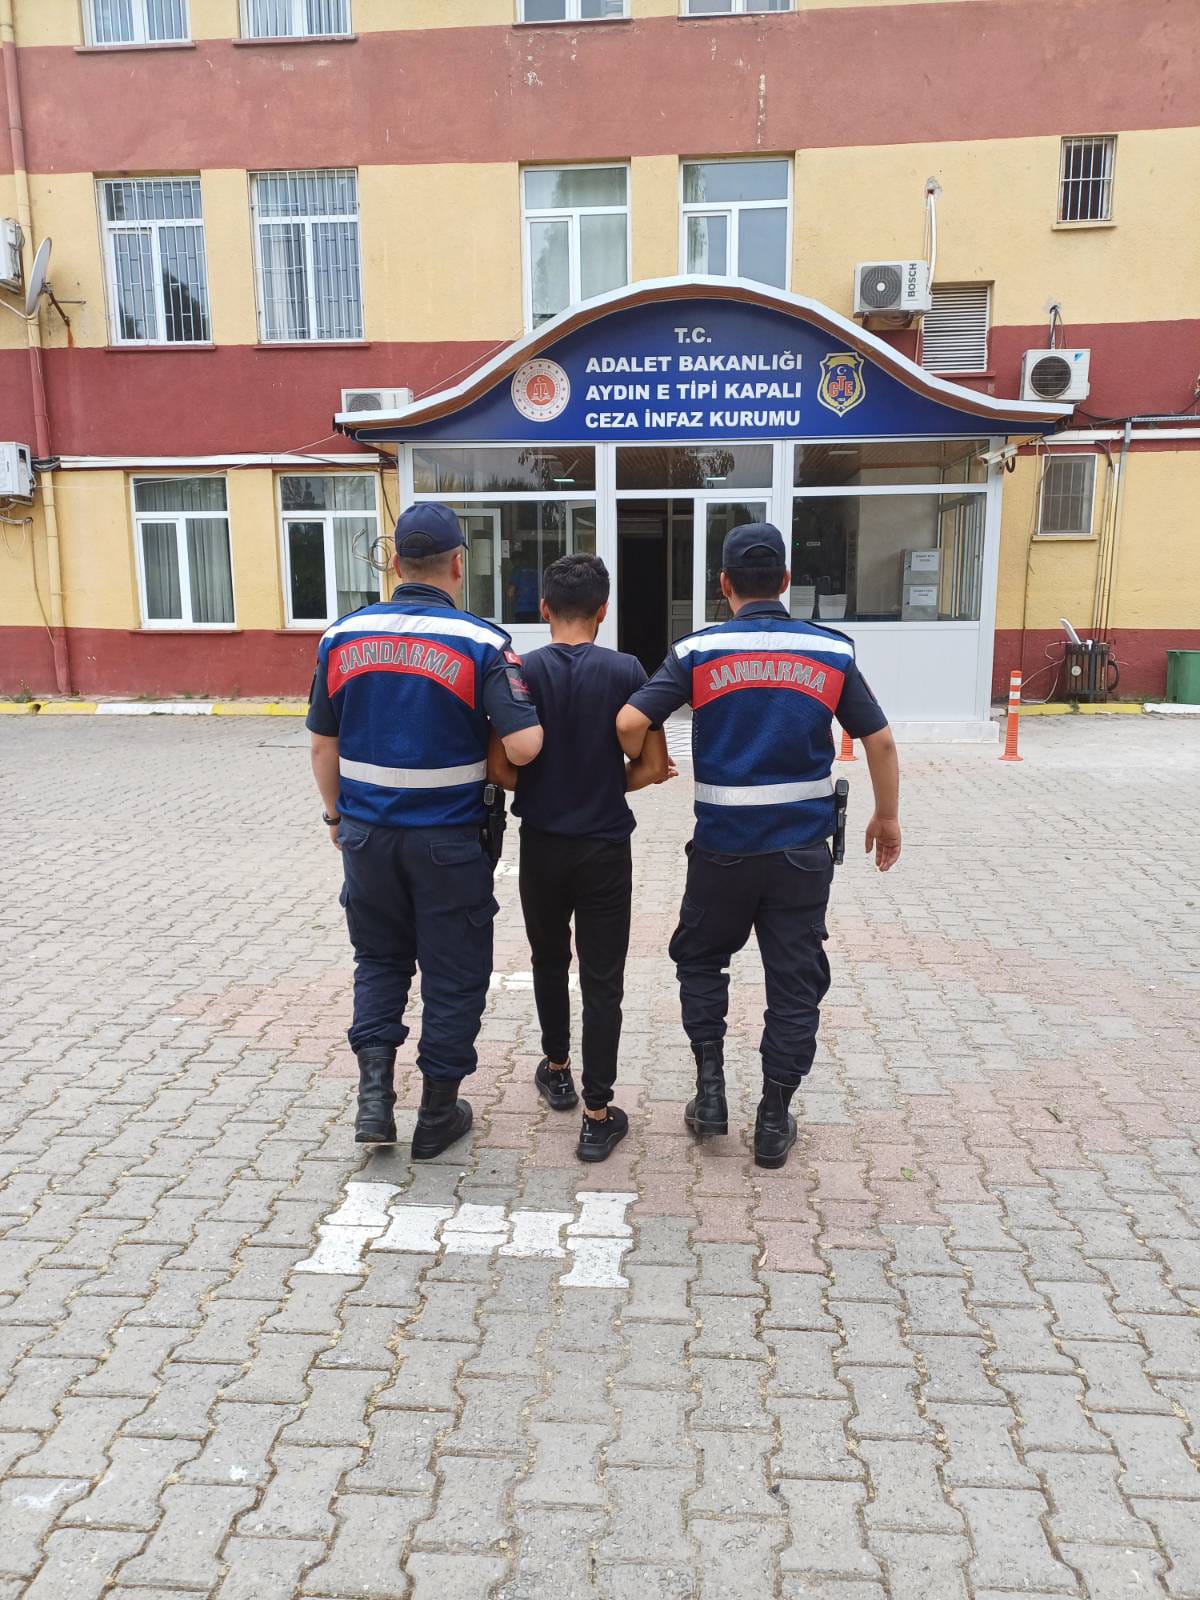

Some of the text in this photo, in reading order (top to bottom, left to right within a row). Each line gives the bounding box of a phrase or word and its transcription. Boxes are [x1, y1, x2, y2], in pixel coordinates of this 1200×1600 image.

[907, 263, 917, 297] BOSCH
[674, 327, 712, 343] T.C.
[585, 350, 803, 373] ADALET BAKANLIĞI
[585, 380, 802, 401] AYDIN E TİPİ KAPALI
[585, 408, 801, 428] CEZA İNFAZ KURUMU
[338, 640, 462, 685] JANDARMA
[709, 660, 827, 693] JANDARMA
